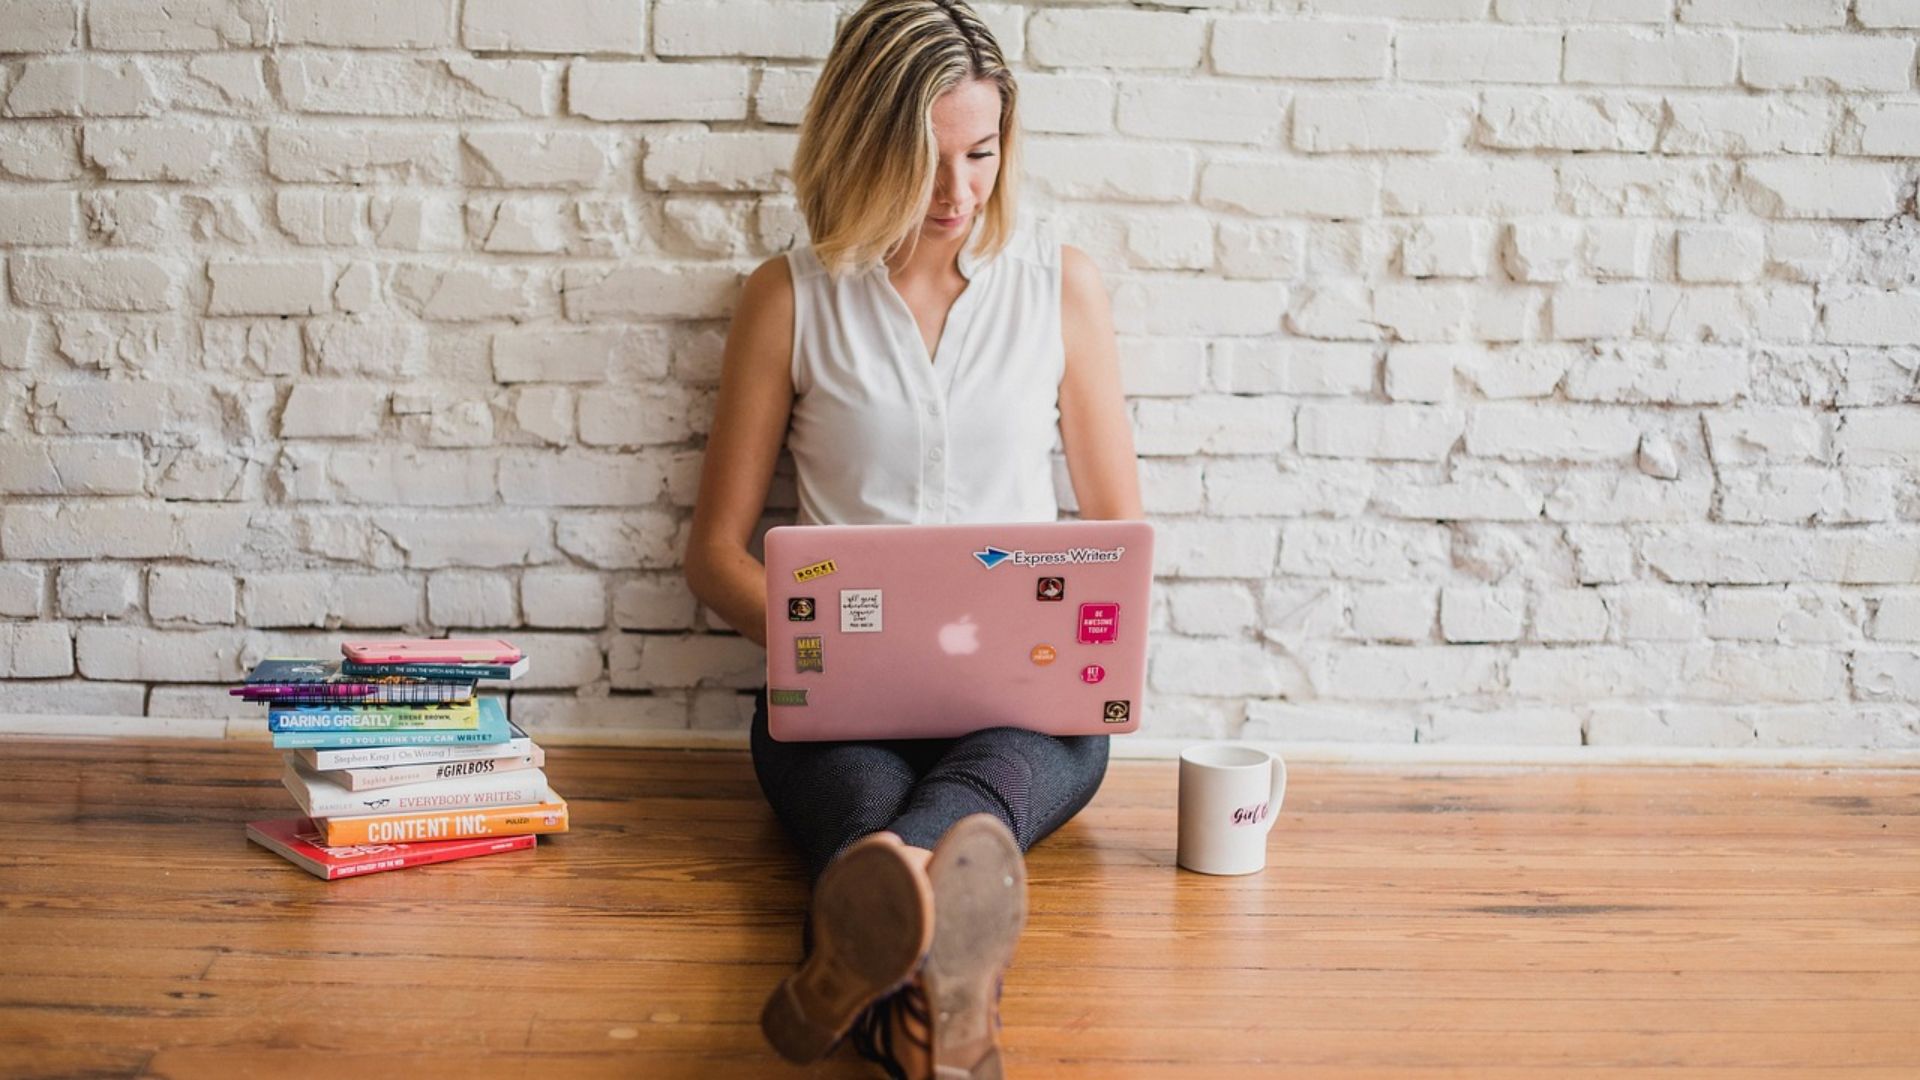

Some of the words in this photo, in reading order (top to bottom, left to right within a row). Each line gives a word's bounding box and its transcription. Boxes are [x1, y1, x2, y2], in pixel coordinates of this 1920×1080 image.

[1015, 551, 1066, 566] Express
[797, 639, 820, 649] MAKE
[280, 714, 331, 727] DARING
[333, 714, 393, 726] GREATLY
[340, 736, 352, 744] SO
[355, 736, 376, 744] YOU
[411, 735, 432, 743] YOU
[456, 733, 492, 741] WRITE?
[334, 753, 368, 764] Stephen
[370, 752, 389, 762] King
[398, 750, 412, 758] On
[415, 749, 445, 759] Writing
[436, 759, 495, 778] #GIRLBOSS
[399, 793, 470, 808] EVERYBODY
[474, 790, 522, 803] WRITES
[368, 817, 449, 842] CONTENT
[455, 814, 492, 835] INC.
